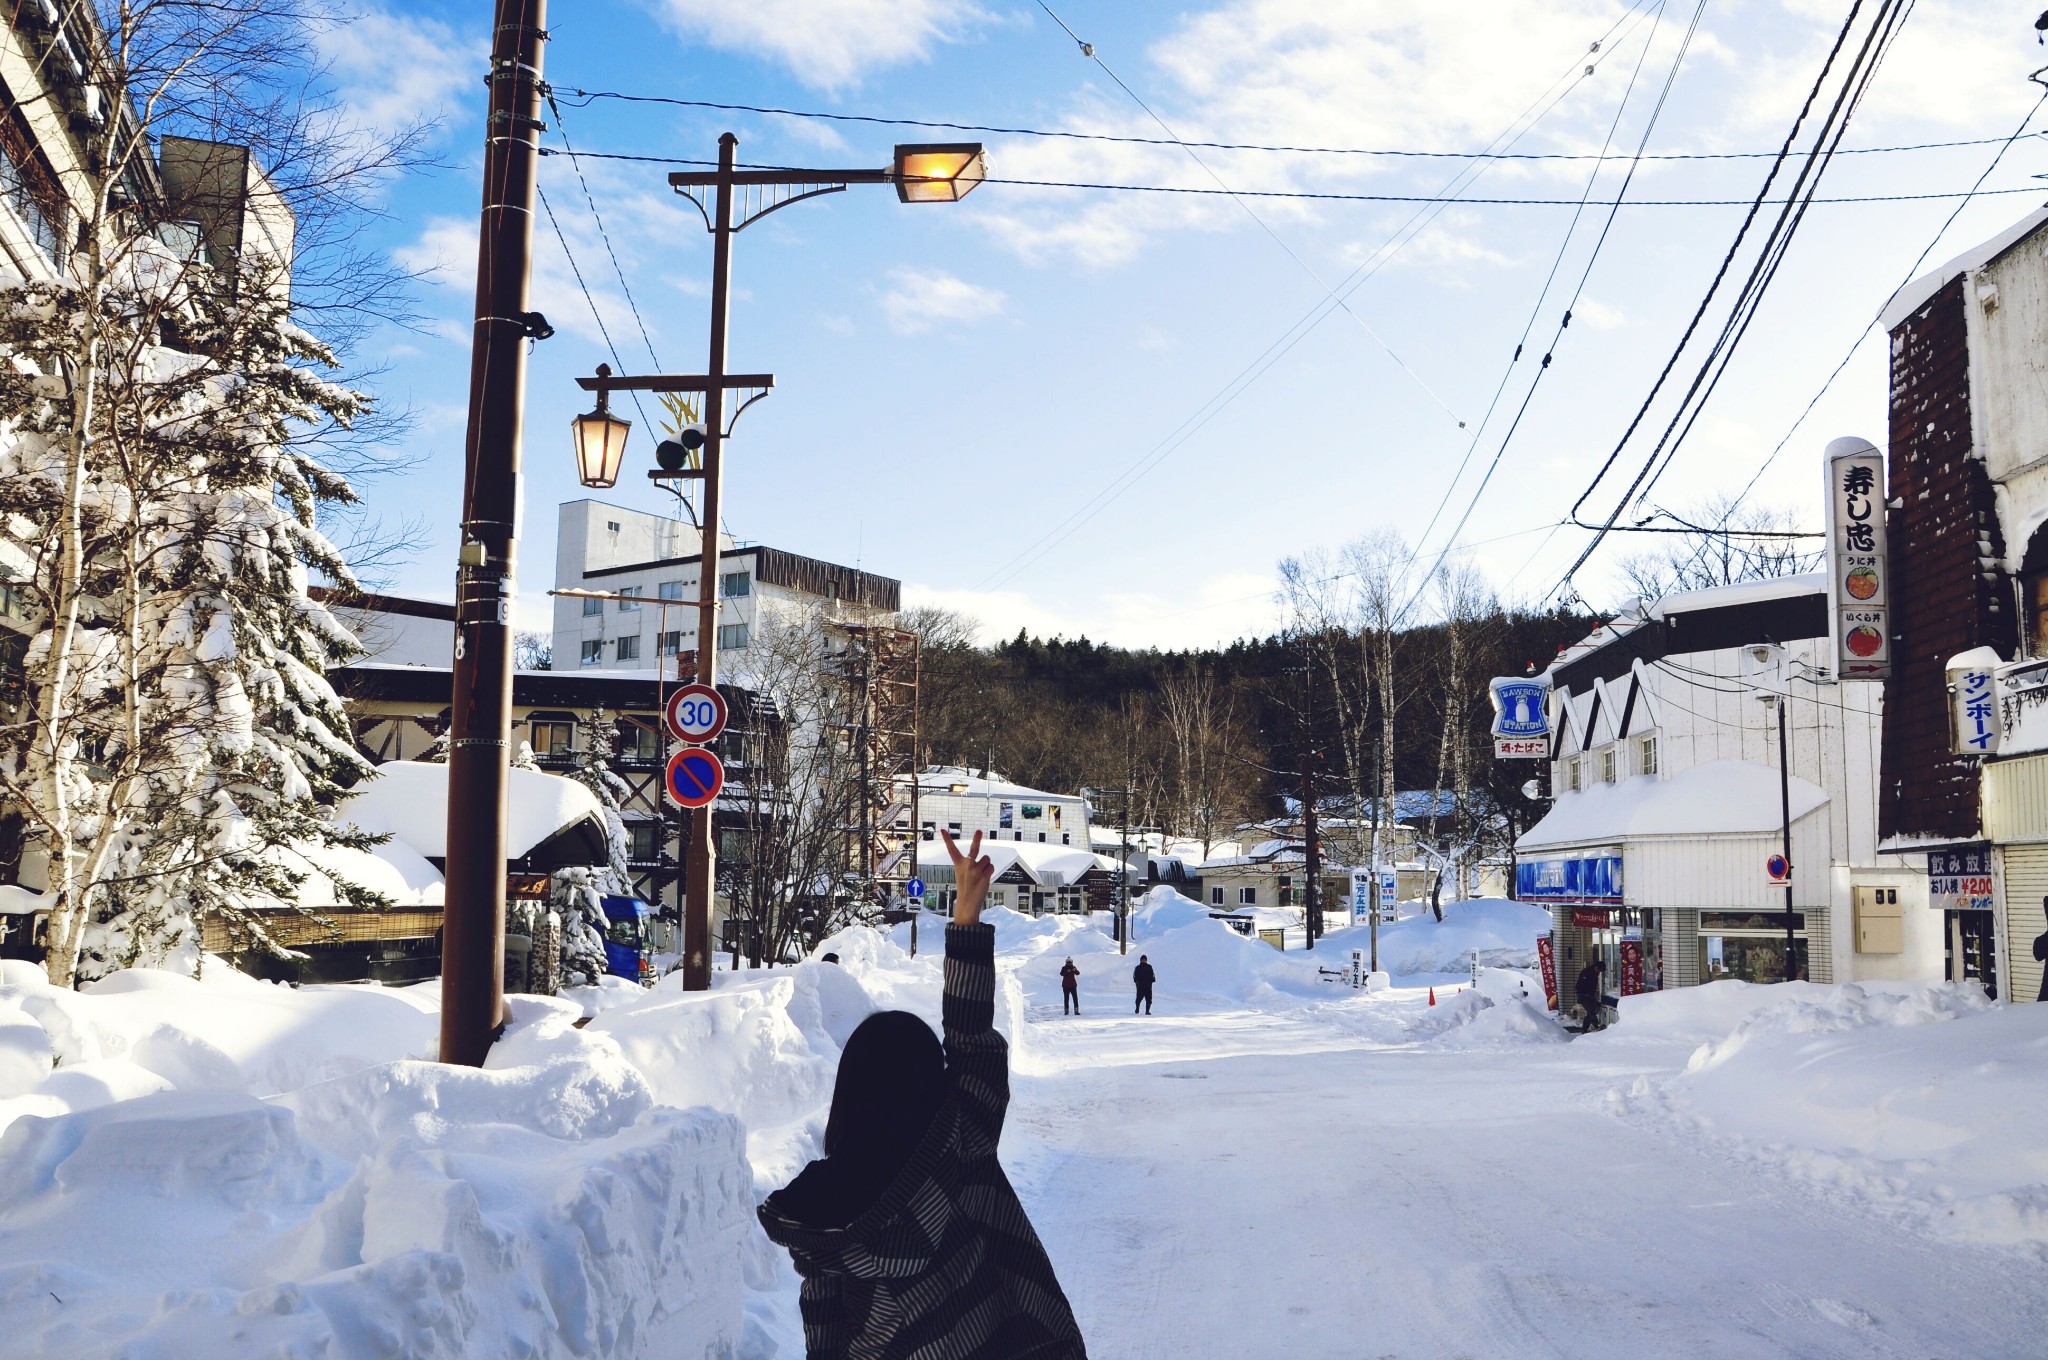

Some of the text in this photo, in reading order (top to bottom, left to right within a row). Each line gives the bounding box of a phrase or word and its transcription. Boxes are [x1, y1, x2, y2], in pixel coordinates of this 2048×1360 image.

[1843, 465, 1876, 552] 寿し忠
[1847, 556, 1877, 567] うに丼
[1845, 612, 1881, 623] いくら丼
[1502, 688, 1541, 698] LAWSON
[680, 700, 713, 727] 30
[1963, 671, 1994, 750] サンボーイ
[1503, 719, 1542, 730] STATION
